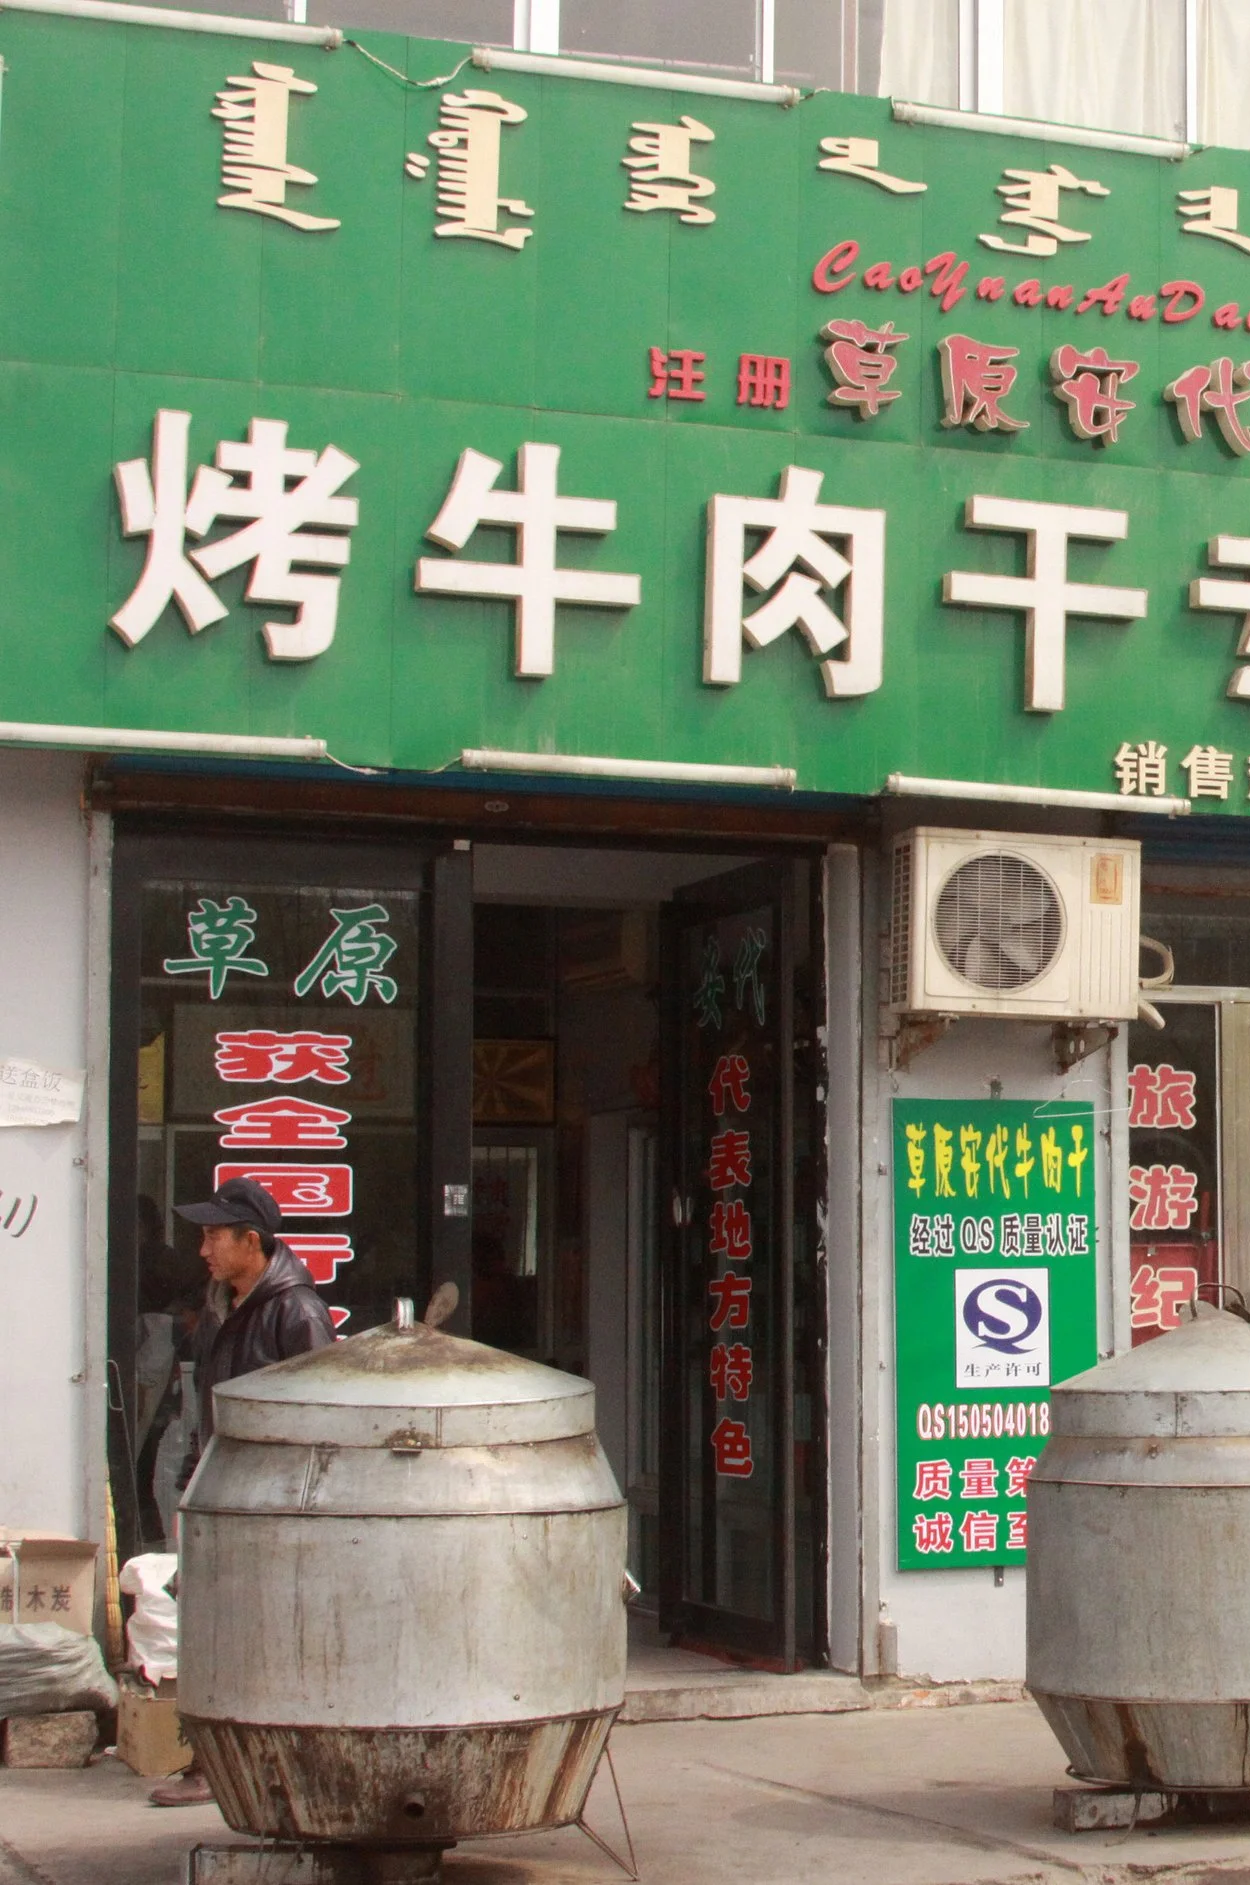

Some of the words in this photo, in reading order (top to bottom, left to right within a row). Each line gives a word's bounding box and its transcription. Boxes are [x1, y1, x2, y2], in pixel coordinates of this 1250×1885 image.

[164, 896, 398, 1006] 草原
[213, 1030, 355, 1343] 获全国
[905, 1121, 1089, 1200] 草原安代牛肉干
[1127, 1063, 1198, 1331] 旅游纪
[708, 1053, 754, 1479] 代表地方特色
[909, 1213, 955, 1257] 经过
[960, 1215, 995, 1256] QS
[1000, 1213, 1090, 1257] 质量认证
[963, 1361, 1042, 1379] 生产许可
